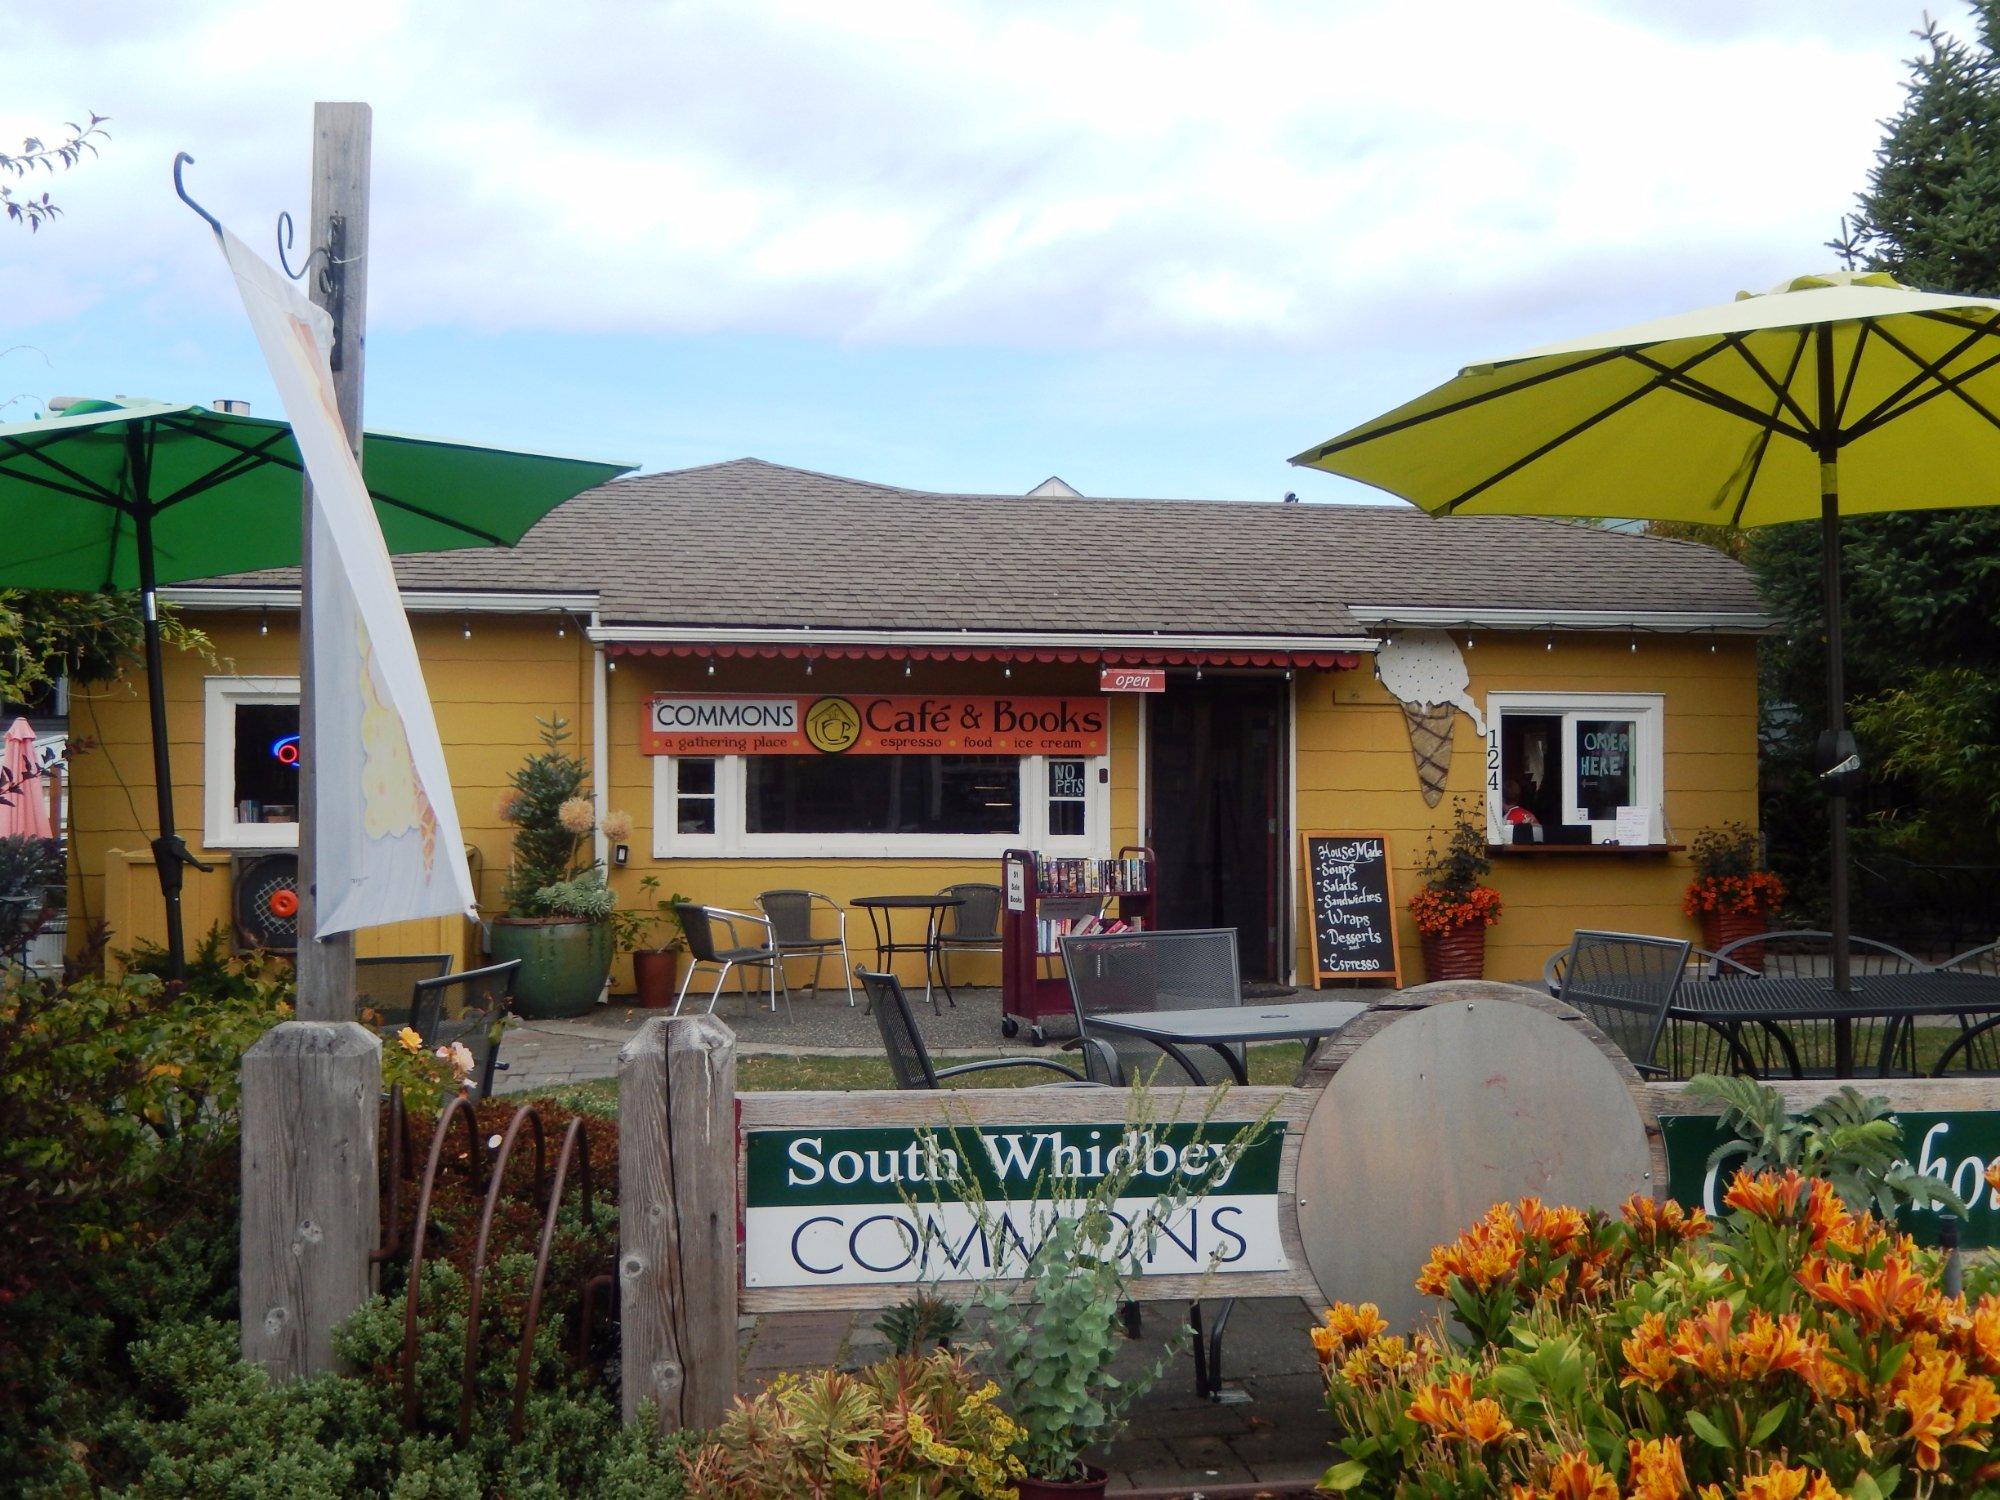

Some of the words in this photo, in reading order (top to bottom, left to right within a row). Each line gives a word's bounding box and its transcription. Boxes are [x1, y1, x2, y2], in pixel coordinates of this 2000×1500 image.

[1115, 675, 1150, 689] open
[657, 705, 794, 726] COMMONS
[866, 699, 951, 733] Café
[960, 704, 983, 729] &
[993, 700, 1103, 733] Books
[665, 738, 673, 747] a
[678, 737, 747, 751] gathering
[754, 737, 787, 750] place
[880, 738, 941, 750] espresso
[964, 736, 992, 748] food
[1014, 737, 1033, 748] ice
[1041, 738, 1081, 748] cream
[1584, 732, 1629, 752] ORDER
[1054, 764, 1075, 780] NO
[1581, 756, 1622, 777] HERE
[1055, 778, 1084, 794] PETS
[788, 1134, 962, 1186] South
[983, 1130, 1243, 1188] Whidbey
